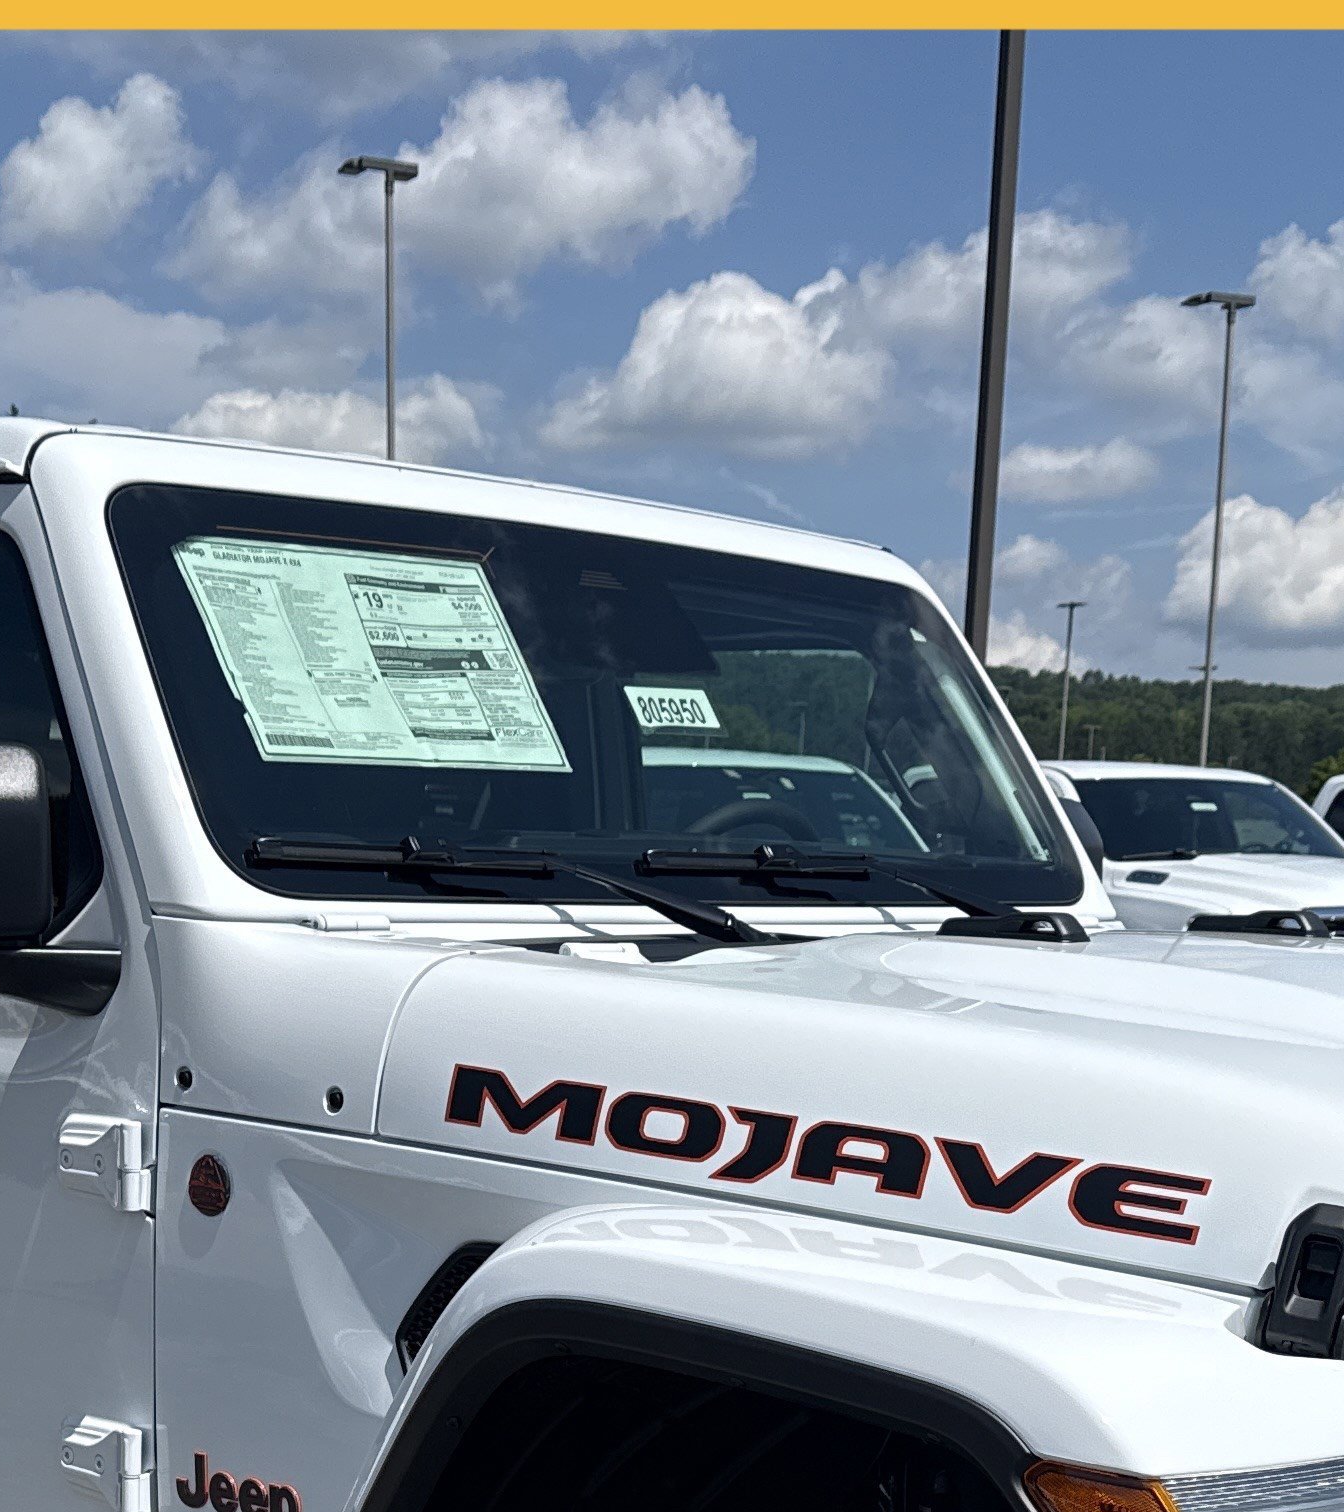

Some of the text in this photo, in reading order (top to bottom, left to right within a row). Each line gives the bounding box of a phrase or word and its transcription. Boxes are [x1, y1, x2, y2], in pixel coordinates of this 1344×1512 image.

[362, 591, 384, 609] 19
[637, 696, 707, 724] 805950
[445, 1063, 1212, 1245] MOJAVE
